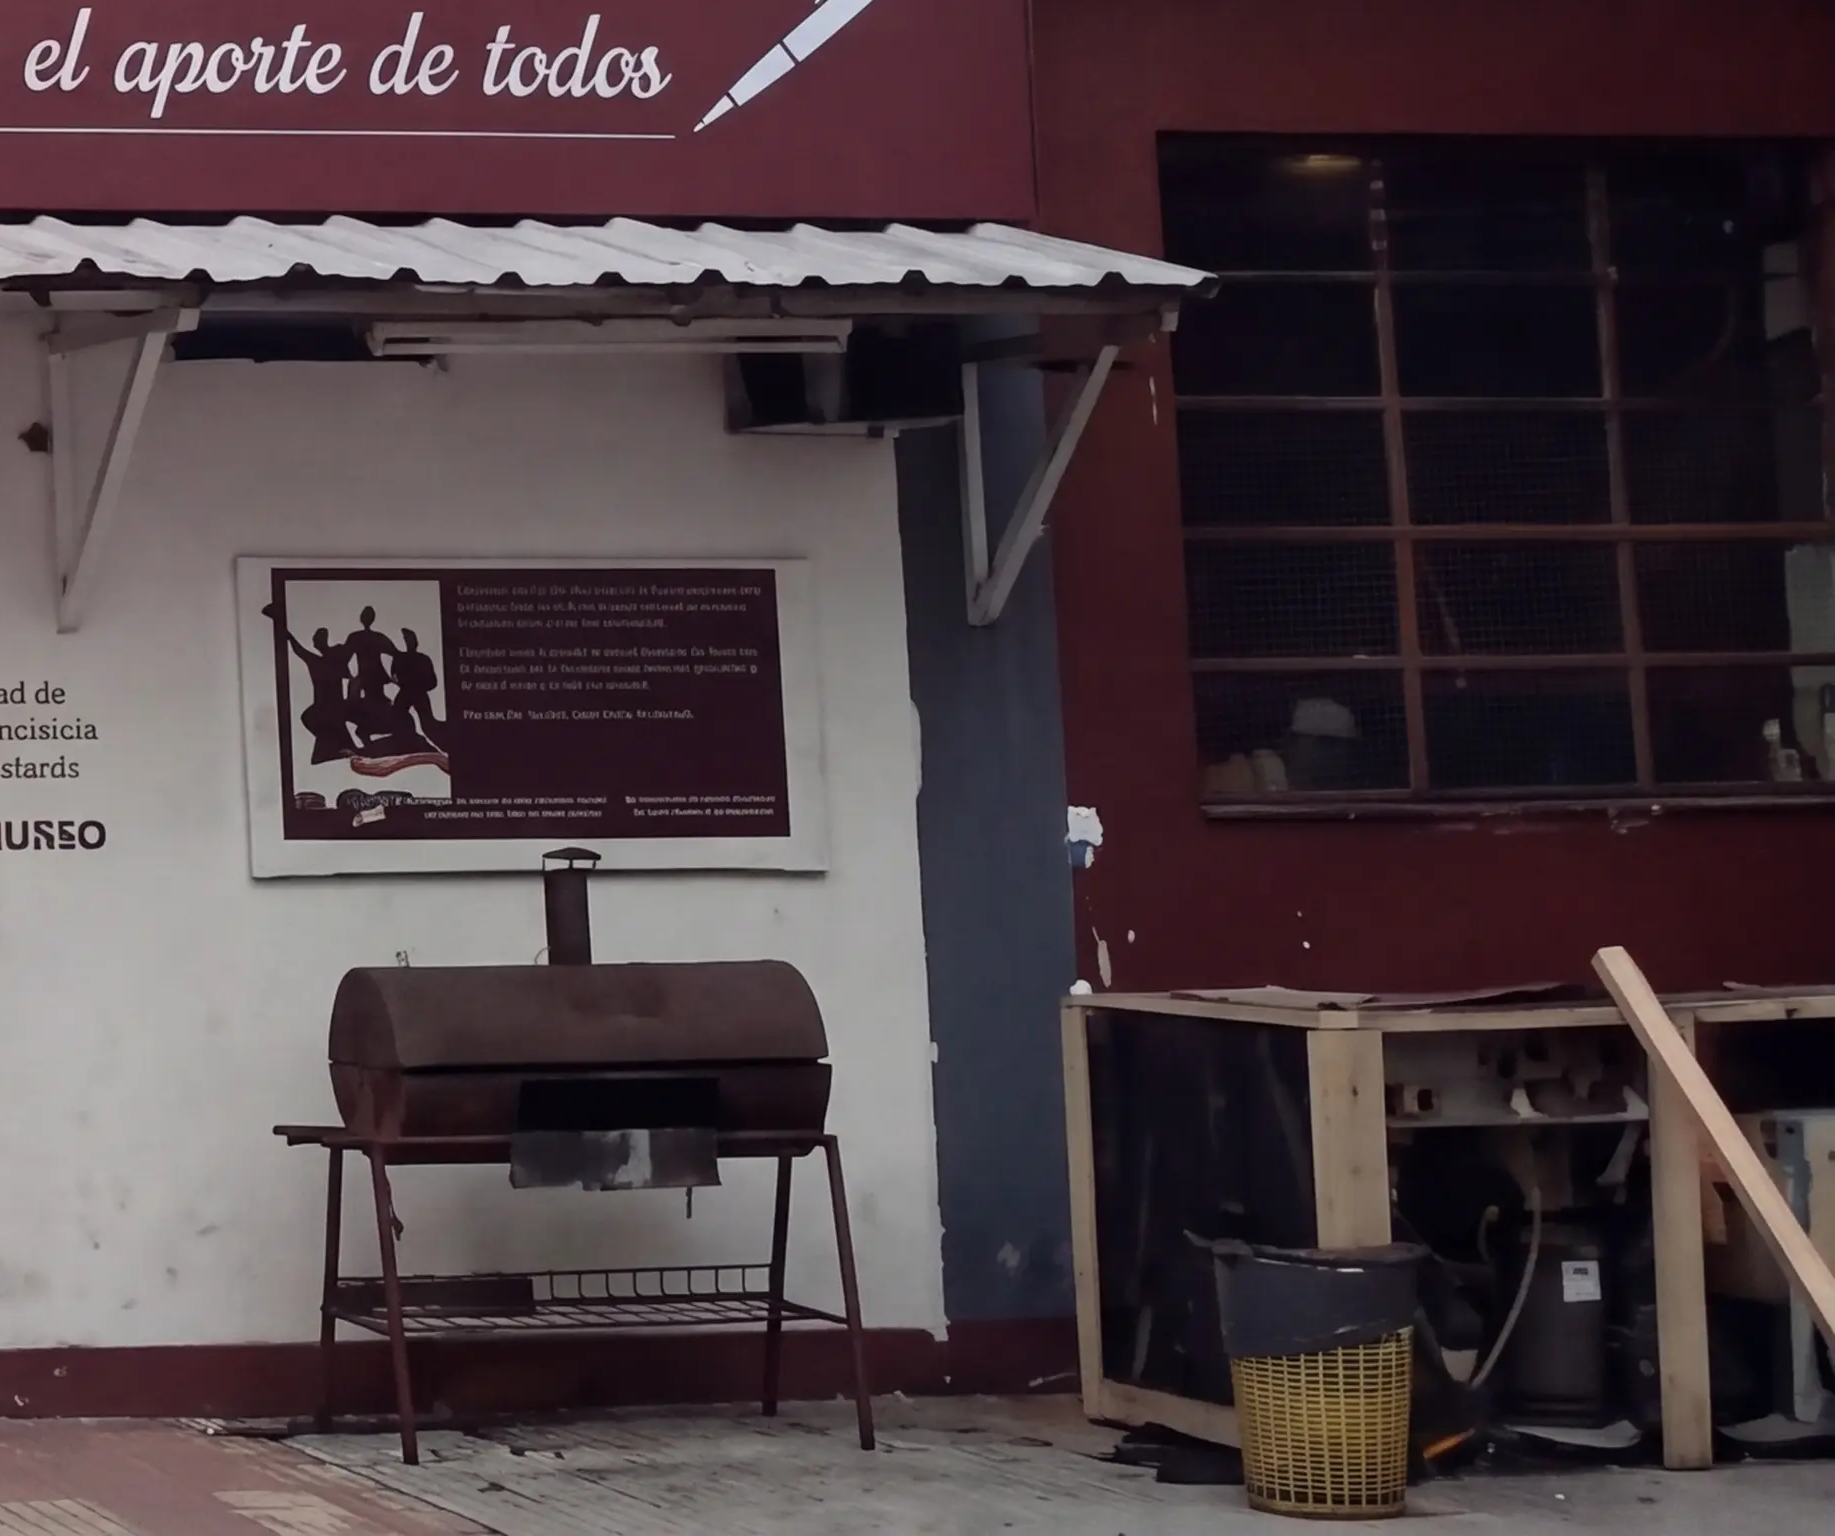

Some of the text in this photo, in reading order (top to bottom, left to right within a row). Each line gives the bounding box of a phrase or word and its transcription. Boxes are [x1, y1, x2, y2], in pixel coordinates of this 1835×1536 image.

[24, 7, 92, 91] el
[114, 23, 347, 119] aporte
[369, 11, 460, 96] de
[482, 13, 673, 99] todos
[34, 680, 66, 705] de
